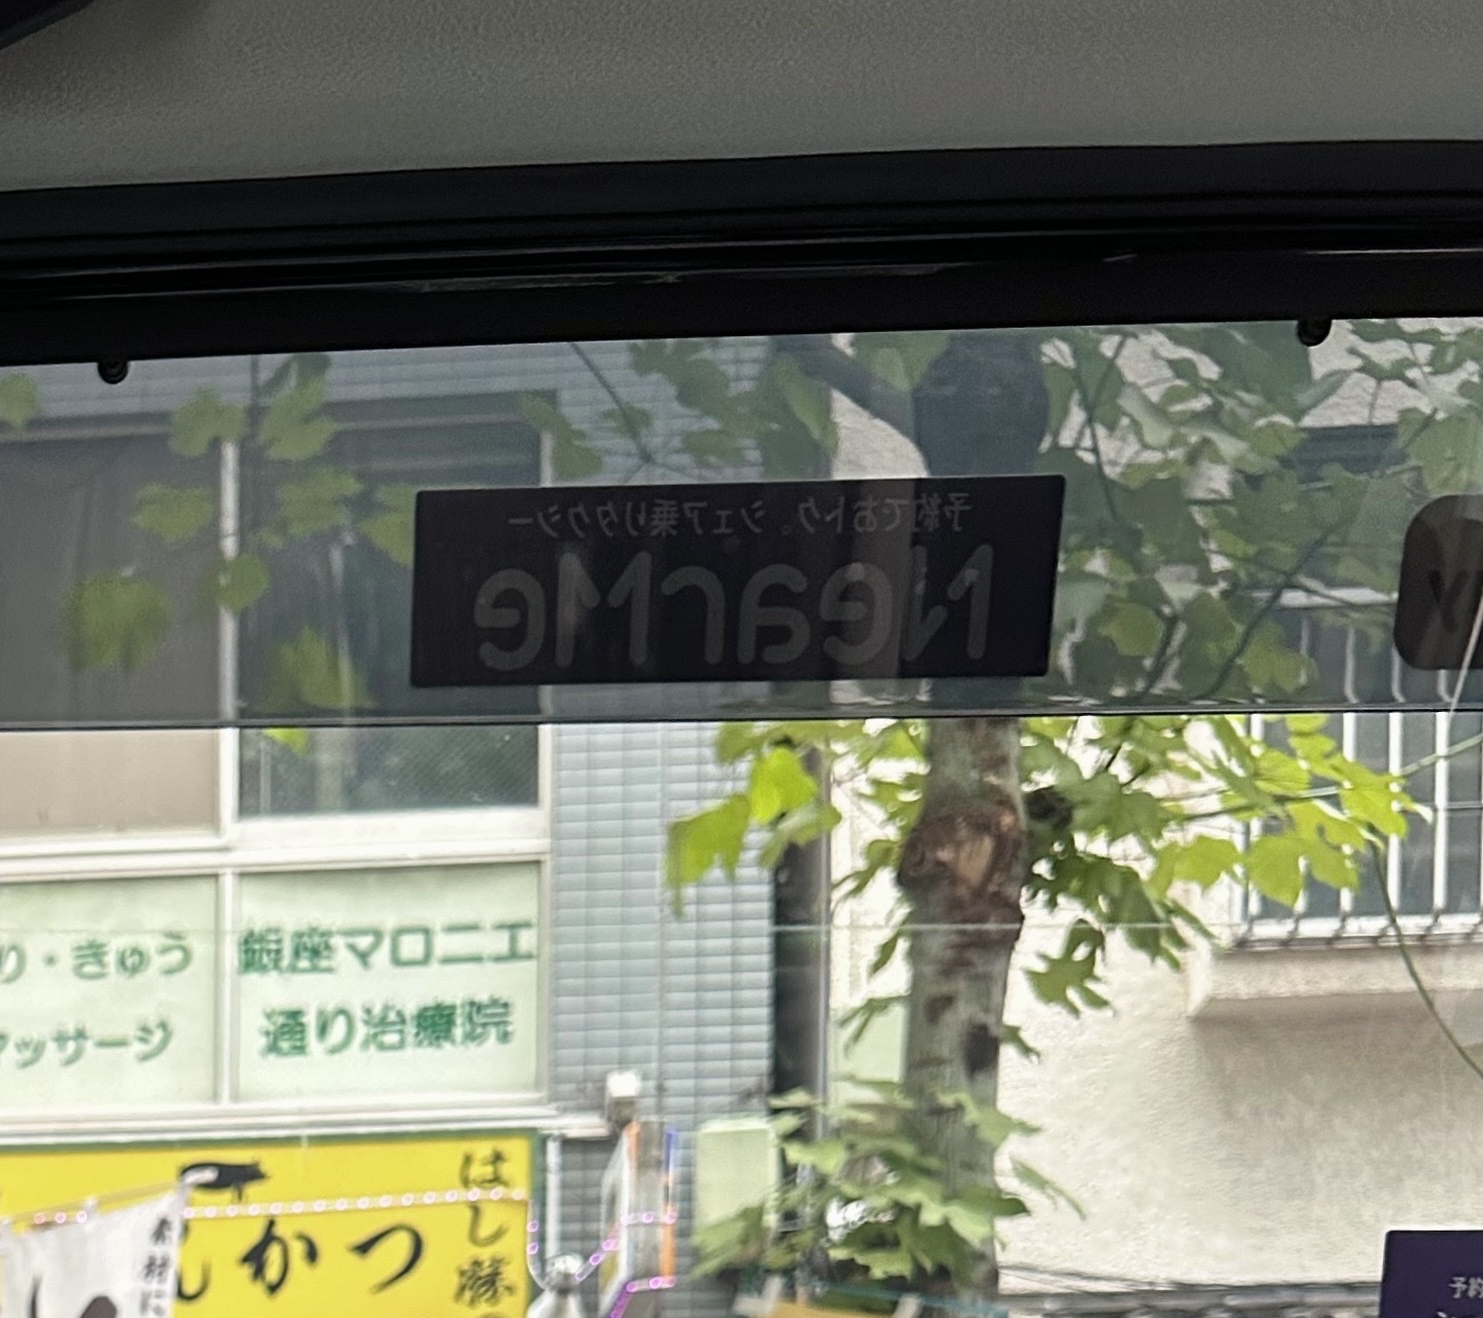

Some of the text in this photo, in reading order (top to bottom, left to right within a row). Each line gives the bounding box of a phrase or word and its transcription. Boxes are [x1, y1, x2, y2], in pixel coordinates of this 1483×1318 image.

[235, 919, 537, 977] 銀座マロニエ
[258, 997, 514, 1060] 通り治療院
